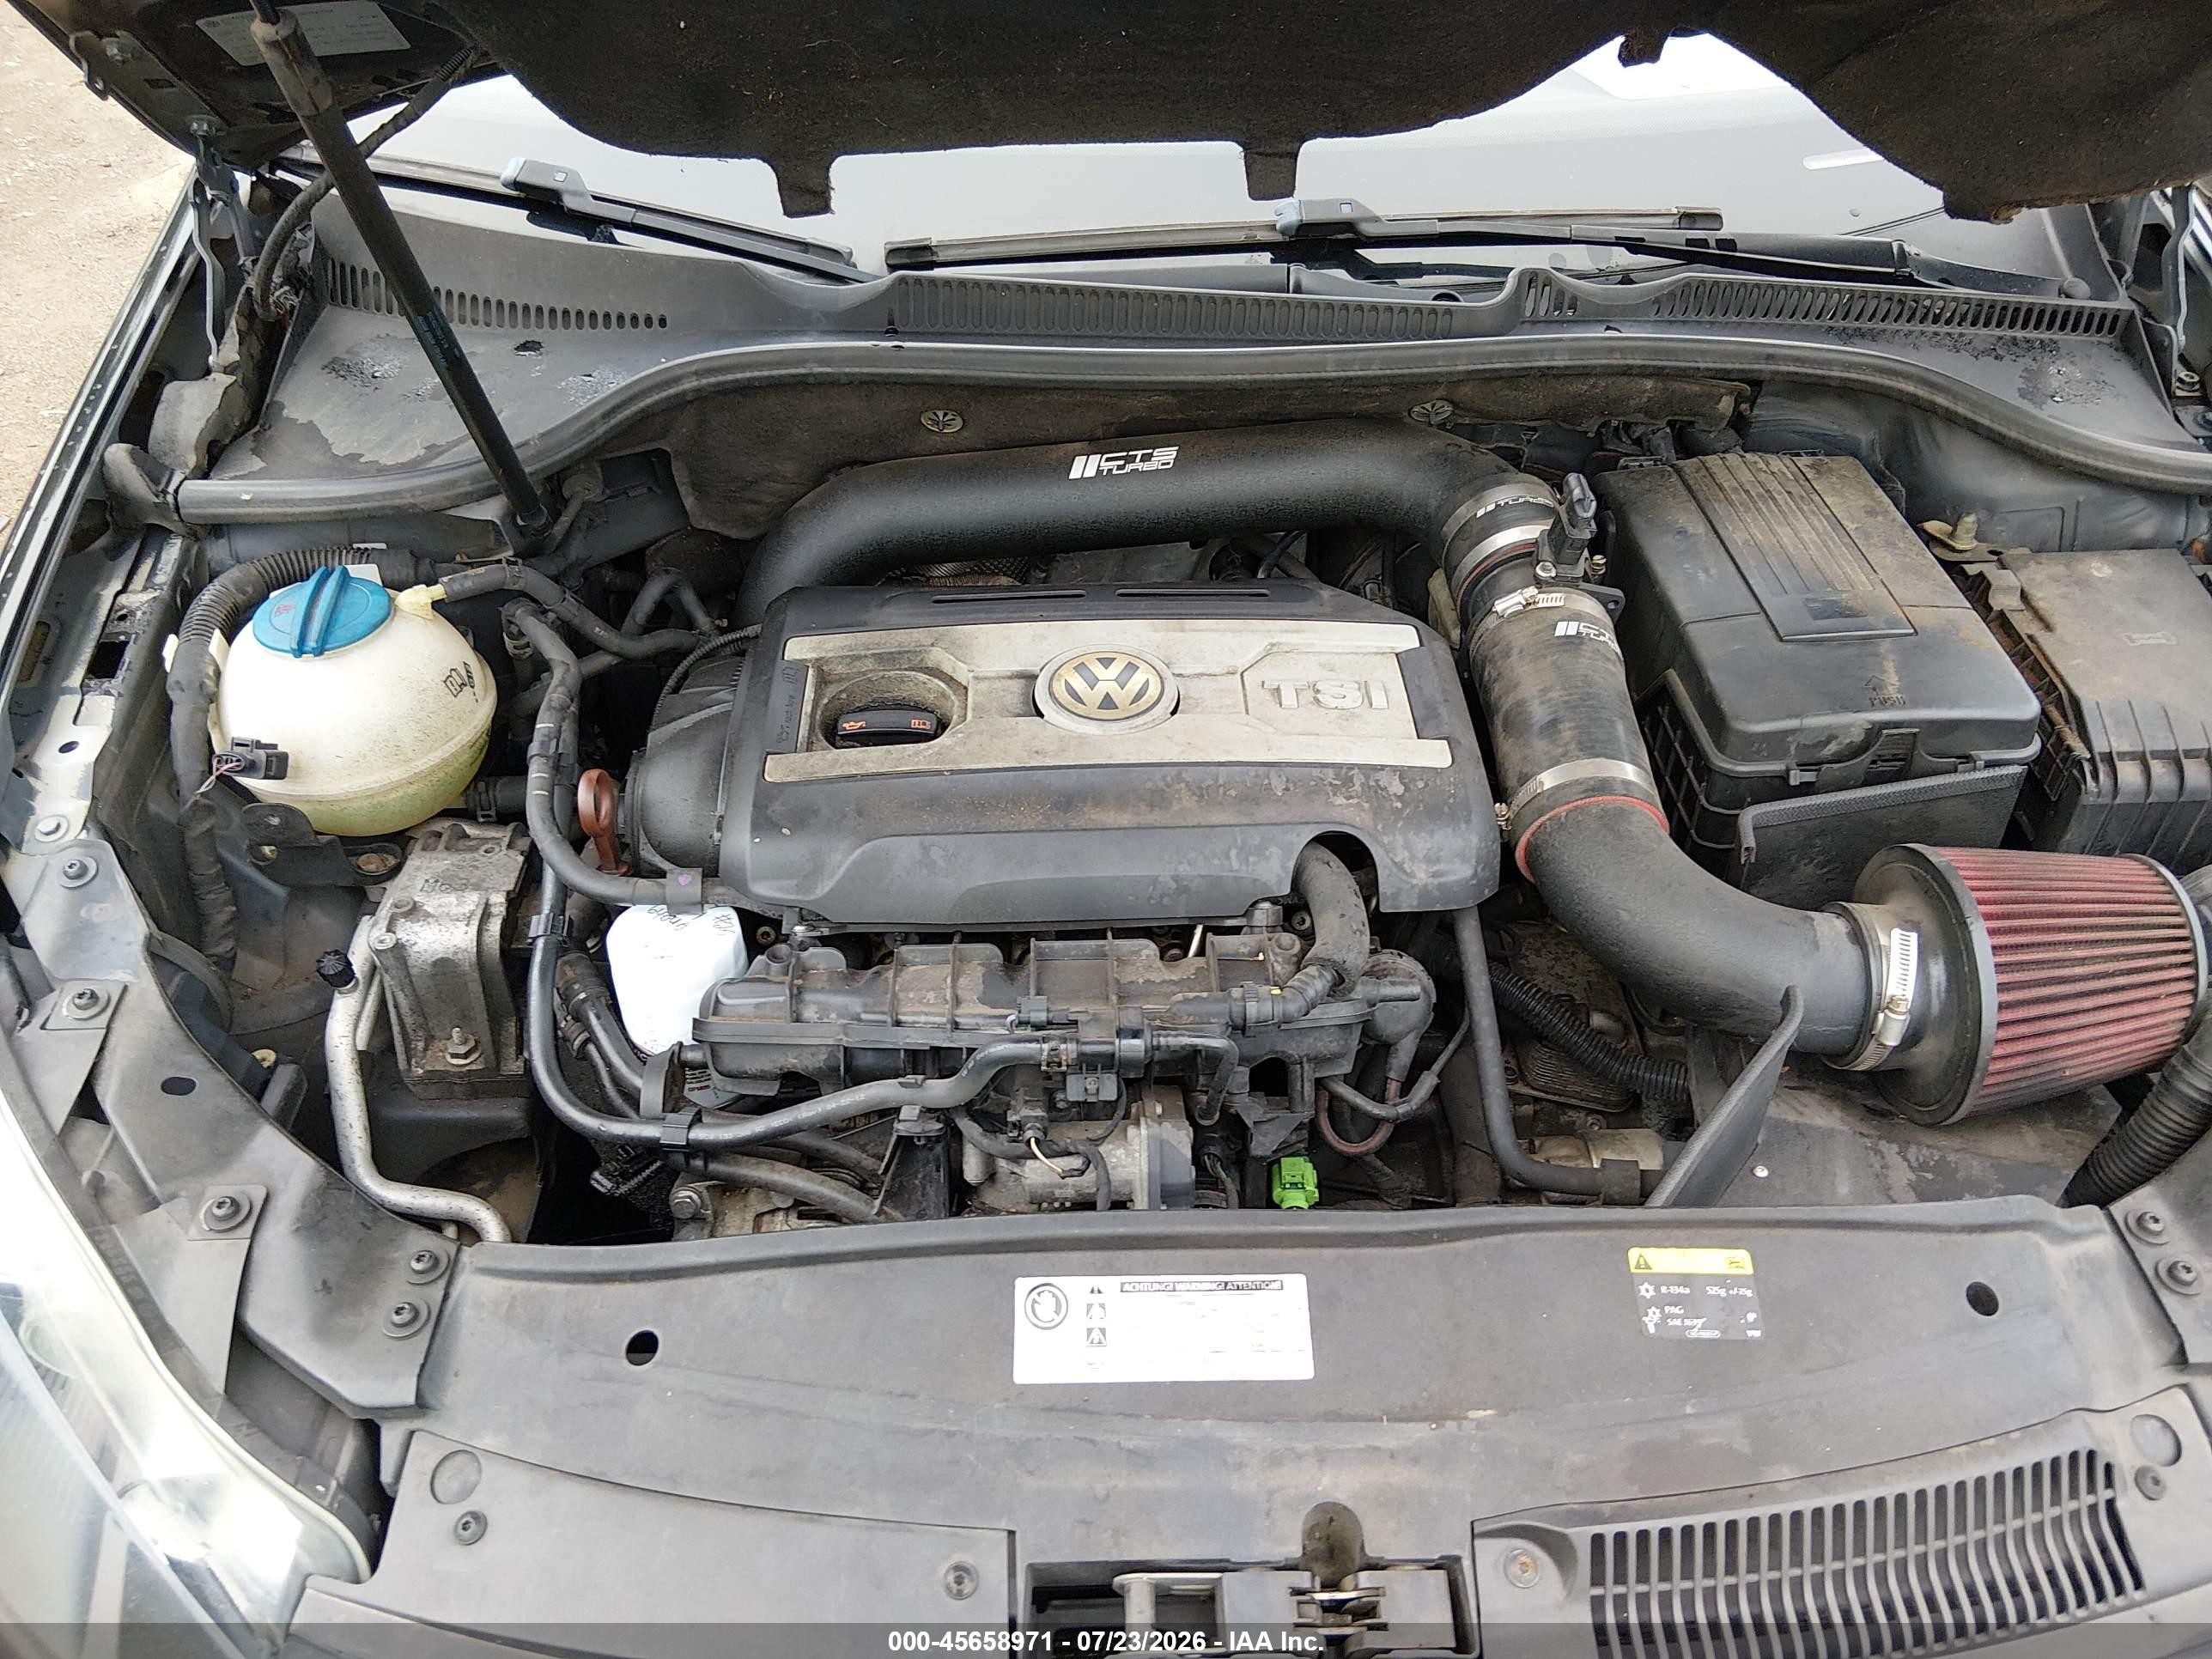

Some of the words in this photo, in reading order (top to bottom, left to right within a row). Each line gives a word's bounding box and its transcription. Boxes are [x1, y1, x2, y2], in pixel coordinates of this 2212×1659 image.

[1100, 446, 1180, 467] CTS
[1098, 459, 1175, 476] TURBO
[1048, 650, 1165, 721] VW
[1261, 679, 1389, 710] TSI
[1663, 1305, 1684, 1314] PAG
